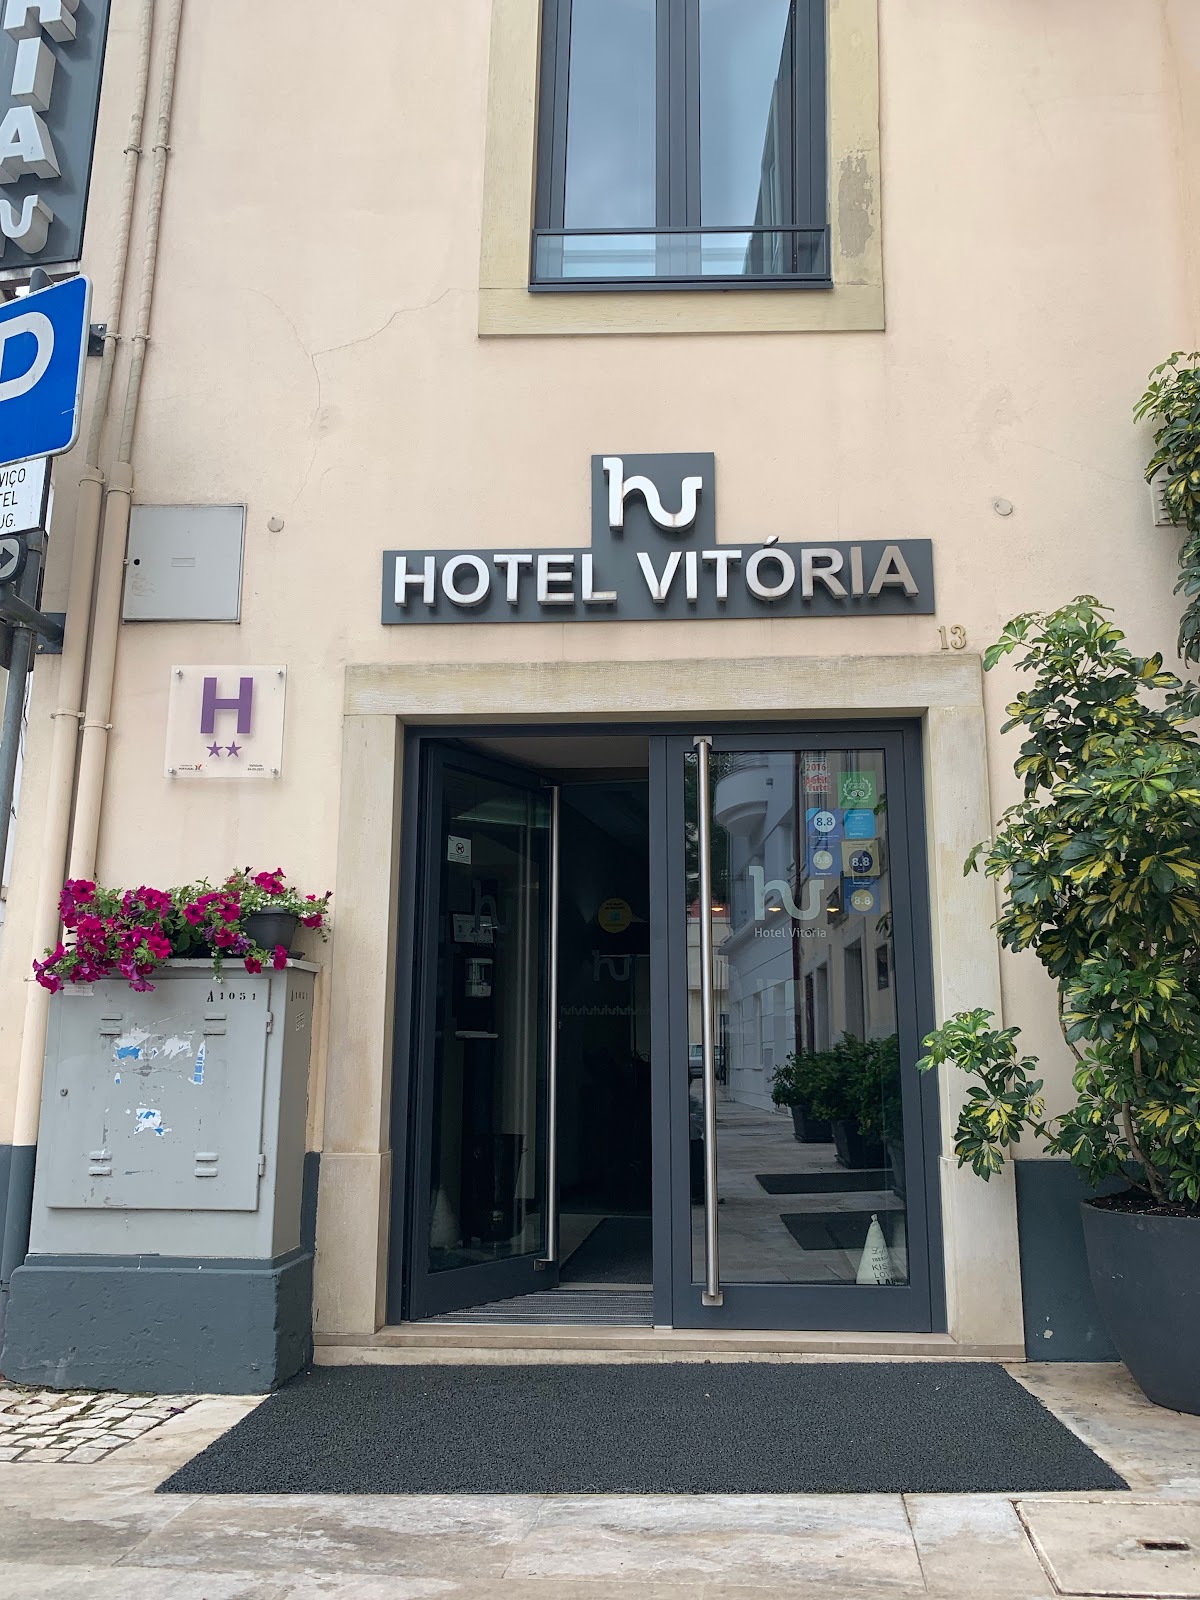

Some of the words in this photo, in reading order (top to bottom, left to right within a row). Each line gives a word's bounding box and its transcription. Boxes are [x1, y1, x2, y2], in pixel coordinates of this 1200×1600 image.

[393, 553, 618, 608] HOTEL
[636, 535, 920, 605] VITÓRIA
[938, 624, 967, 650] 13
[200, 676, 254, 734] H
[806, 763, 827, 772] 2016
[816, 817, 833, 827] 8.8
[816, 856, 830, 864] 8.8
[851, 857, 870, 867] 8.8
[854, 897, 871, 905] 8.8
[754, 927, 786, 938] Hotel
[788, 927, 827, 938] Vitória
